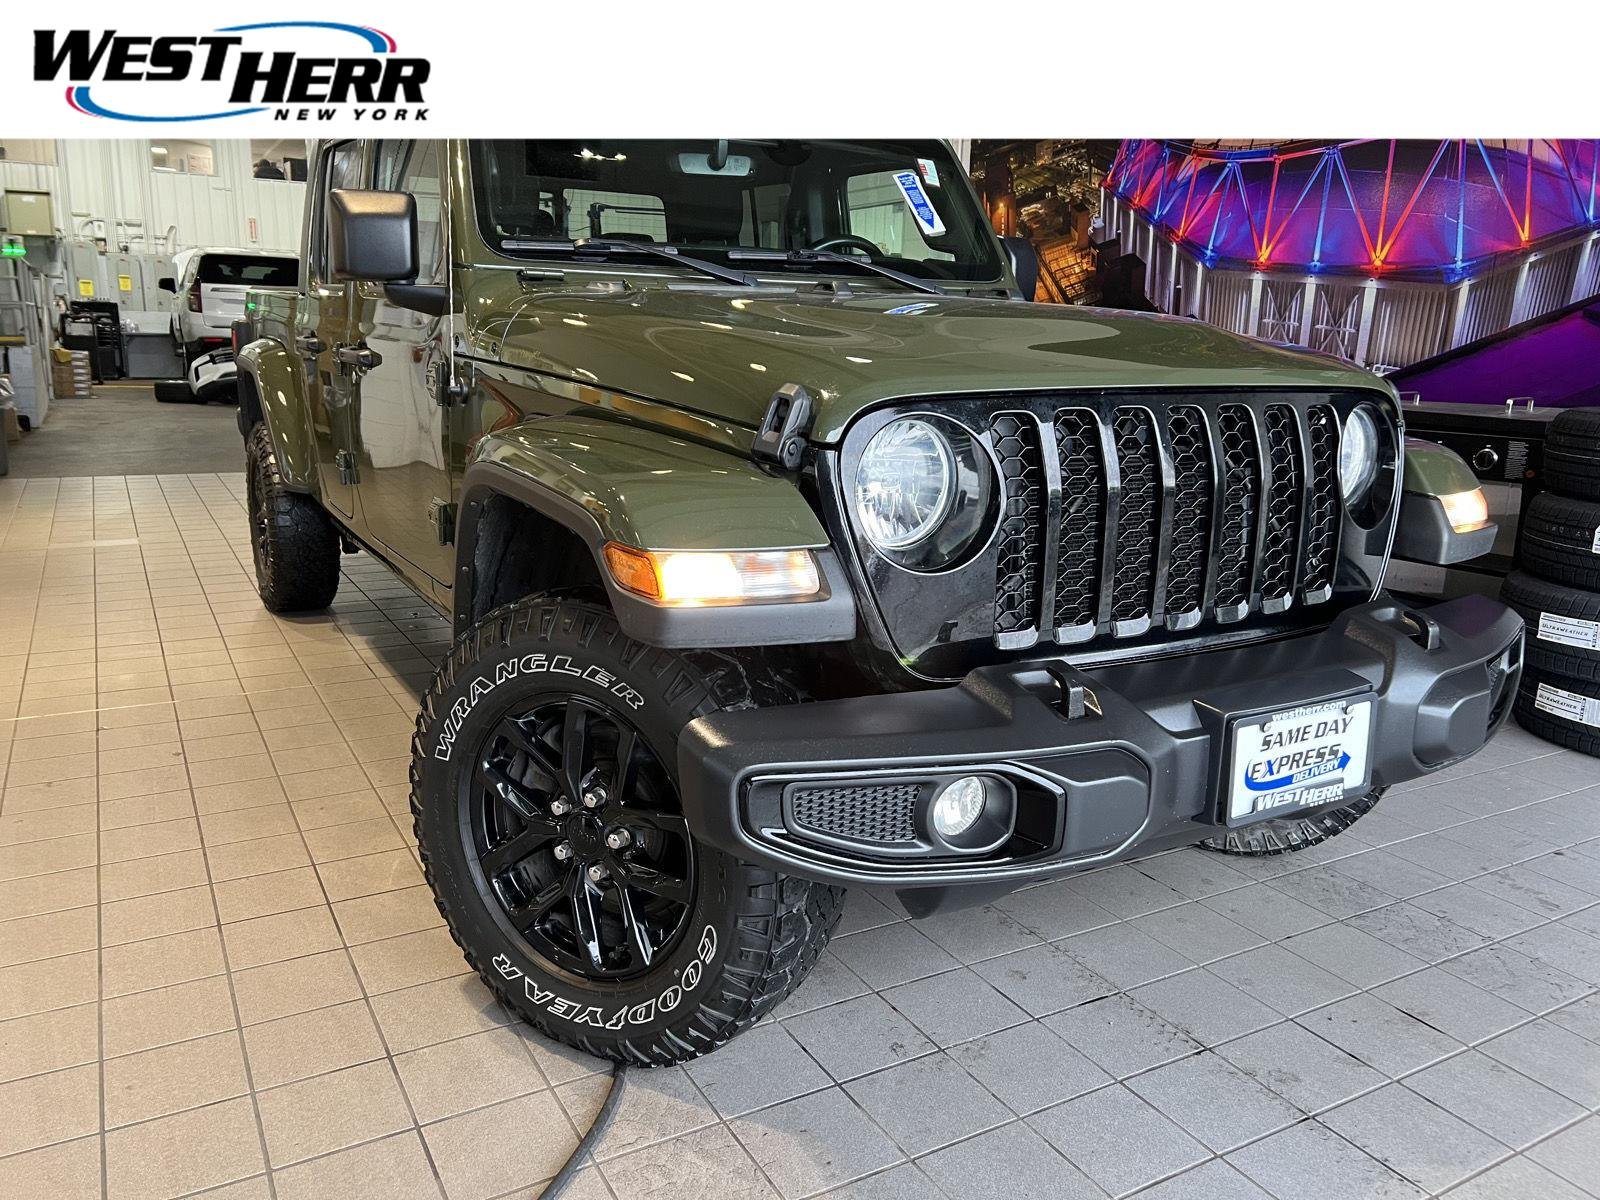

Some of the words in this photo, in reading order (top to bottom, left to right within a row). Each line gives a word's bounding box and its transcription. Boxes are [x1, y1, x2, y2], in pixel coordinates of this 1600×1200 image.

[434, 653, 645, 761] WRANGLER
[1272, 700, 1347, 722] westherr.com
[1260, 724, 1313, 752] SAME
[1314, 716, 1354, 739] DAY
[1250, 743, 1341, 780] EXPRESS
[1292, 758, 1341, 784] DELIVERY
[492, 924, 718, 1030] GOODYEAR
